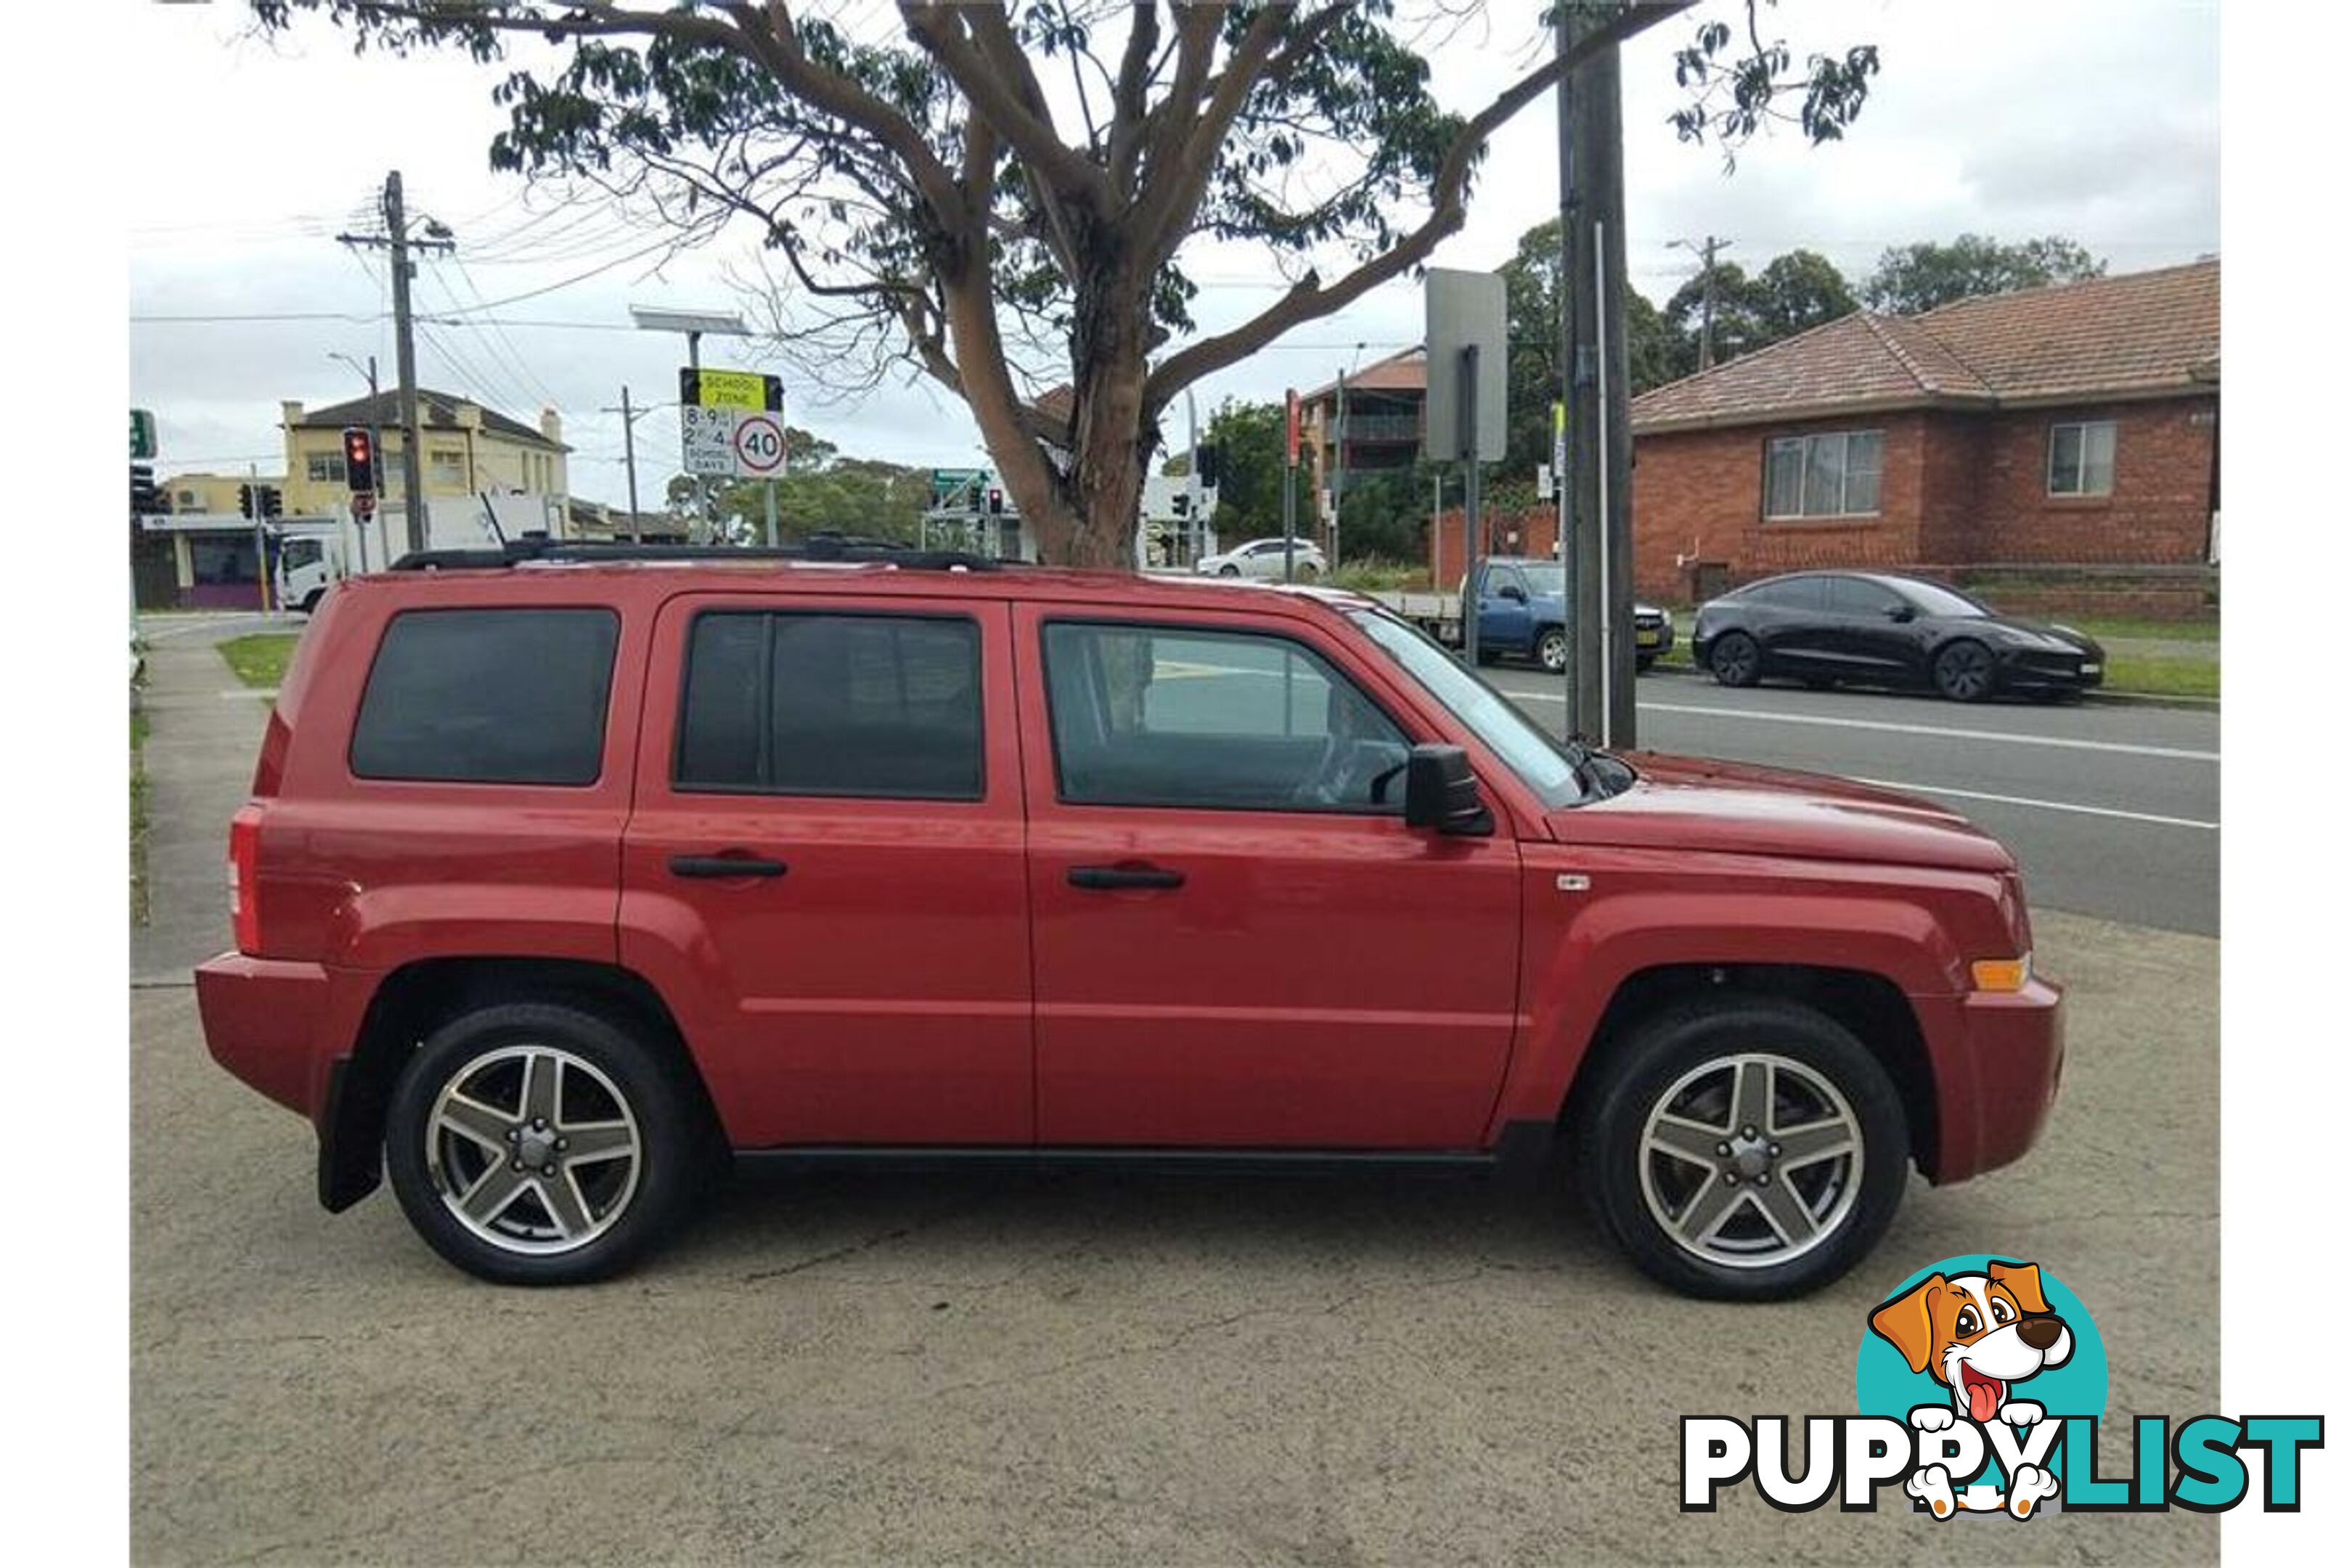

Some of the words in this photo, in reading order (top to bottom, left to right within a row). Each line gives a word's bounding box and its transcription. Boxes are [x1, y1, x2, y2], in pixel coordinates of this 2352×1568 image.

[704, 375, 758, 391] SCHOOL
[715, 391, 750, 404] ZONE
[744, 432, 777, 457] 40
